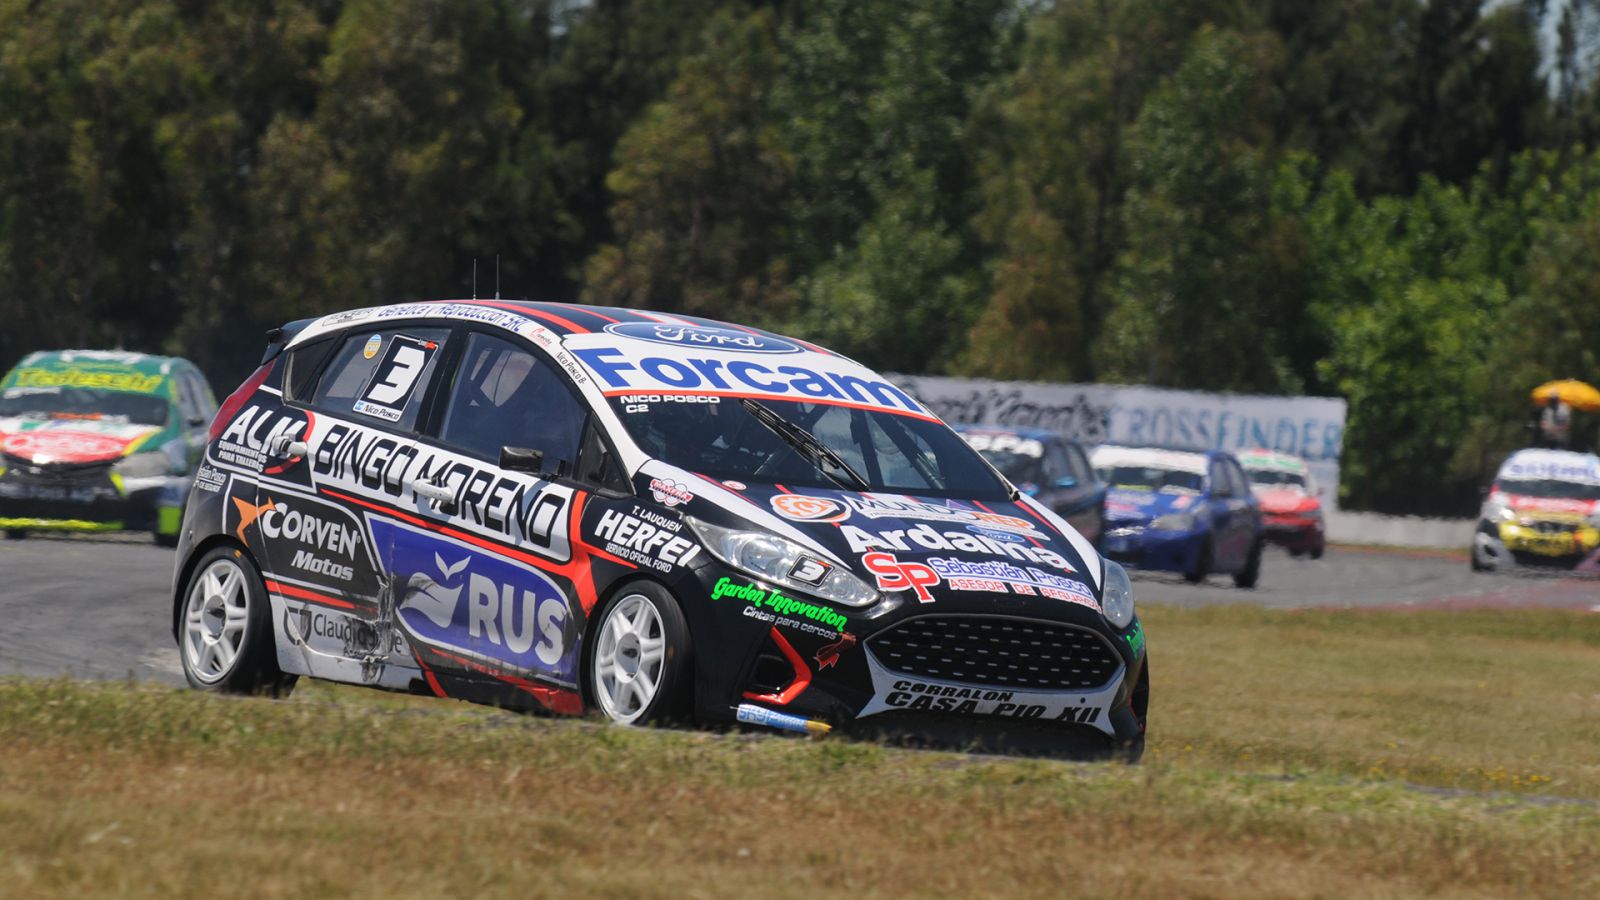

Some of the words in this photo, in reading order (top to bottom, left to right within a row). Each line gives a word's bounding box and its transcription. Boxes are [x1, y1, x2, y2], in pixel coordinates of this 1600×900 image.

[653, 325, 764, 348] Ford
[556, 351, 569, 365] Nico
[367, 345, 425, 404] 3
[571, 347, 923, 412] Forcam
[364, 404, 380, 416] Nico
[379, 408, 400, 420] Posco
[620, 395, 661, 404] NICO
[663, 395, 720, 404] POSCO
[626, 404, 649, 414] C2
[218, 450, 236, 463] PARA
[313, 423, 419, 498] BINGO
[413, 454, 567, 549] MORENO
[262, 502, 359, 561] CORVEN
[632, 505, 641, 515] T.
[640, 508, 683, 532] LAUQUEN
[605, 542, 629, 559] SERVICIO
[629, 549, 652, 567] OFICIAL
[652, 558, 672, 573] FORD
[840, 525, 1079, 573] Ardama
[291, 550, 354, 581] Motos
[794, 560, 825, 581] 3
[862, 552, 940, 603] SP
[929, 557, 1031, 583] Sebastián
[1030, 566, 1093, 596] Posco
[949, 578, 1004, 592] ASESOR
[1013, 584, 1033, 595] DE
[469, 572, 567, 665] RUS
[711, 576, 766, 608] Garden
[764, 588, 848, 632] Innovation
[742, 605, 775, 624] Cintas
[774, 616, 801, 630] para
[801, 622, 838, 640] cercos
[893, 680, 1015, 702] CORRALON
[885, 691, 977, 714] CASA
[996, 703, 1048, 719] PIO
[1055, 706, 1101, 723] XII
